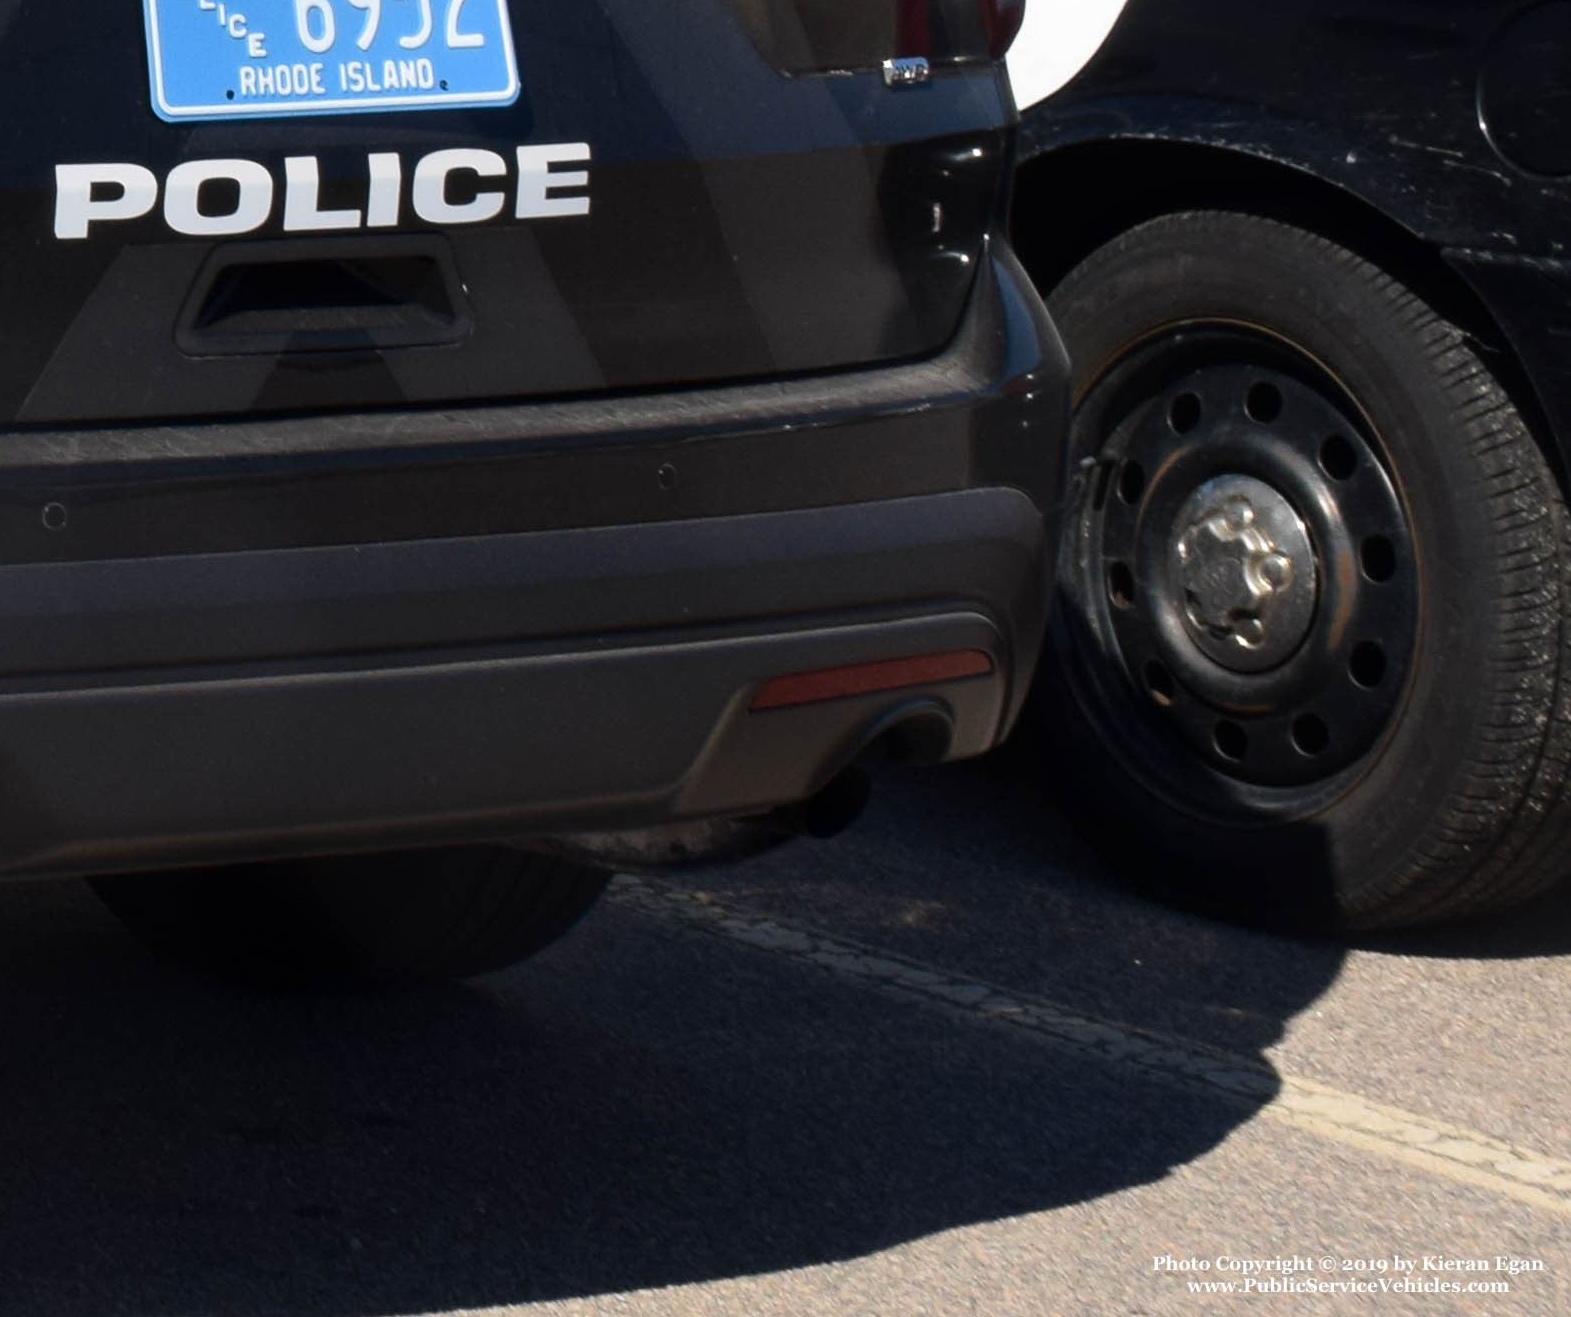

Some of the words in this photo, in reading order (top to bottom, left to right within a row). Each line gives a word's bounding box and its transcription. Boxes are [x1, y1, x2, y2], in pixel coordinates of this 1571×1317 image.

[239, 63, 326, 96] RHODE
[339, 58, 435, 93] ISLAND
[54, 142, 591, 239] POLICE
